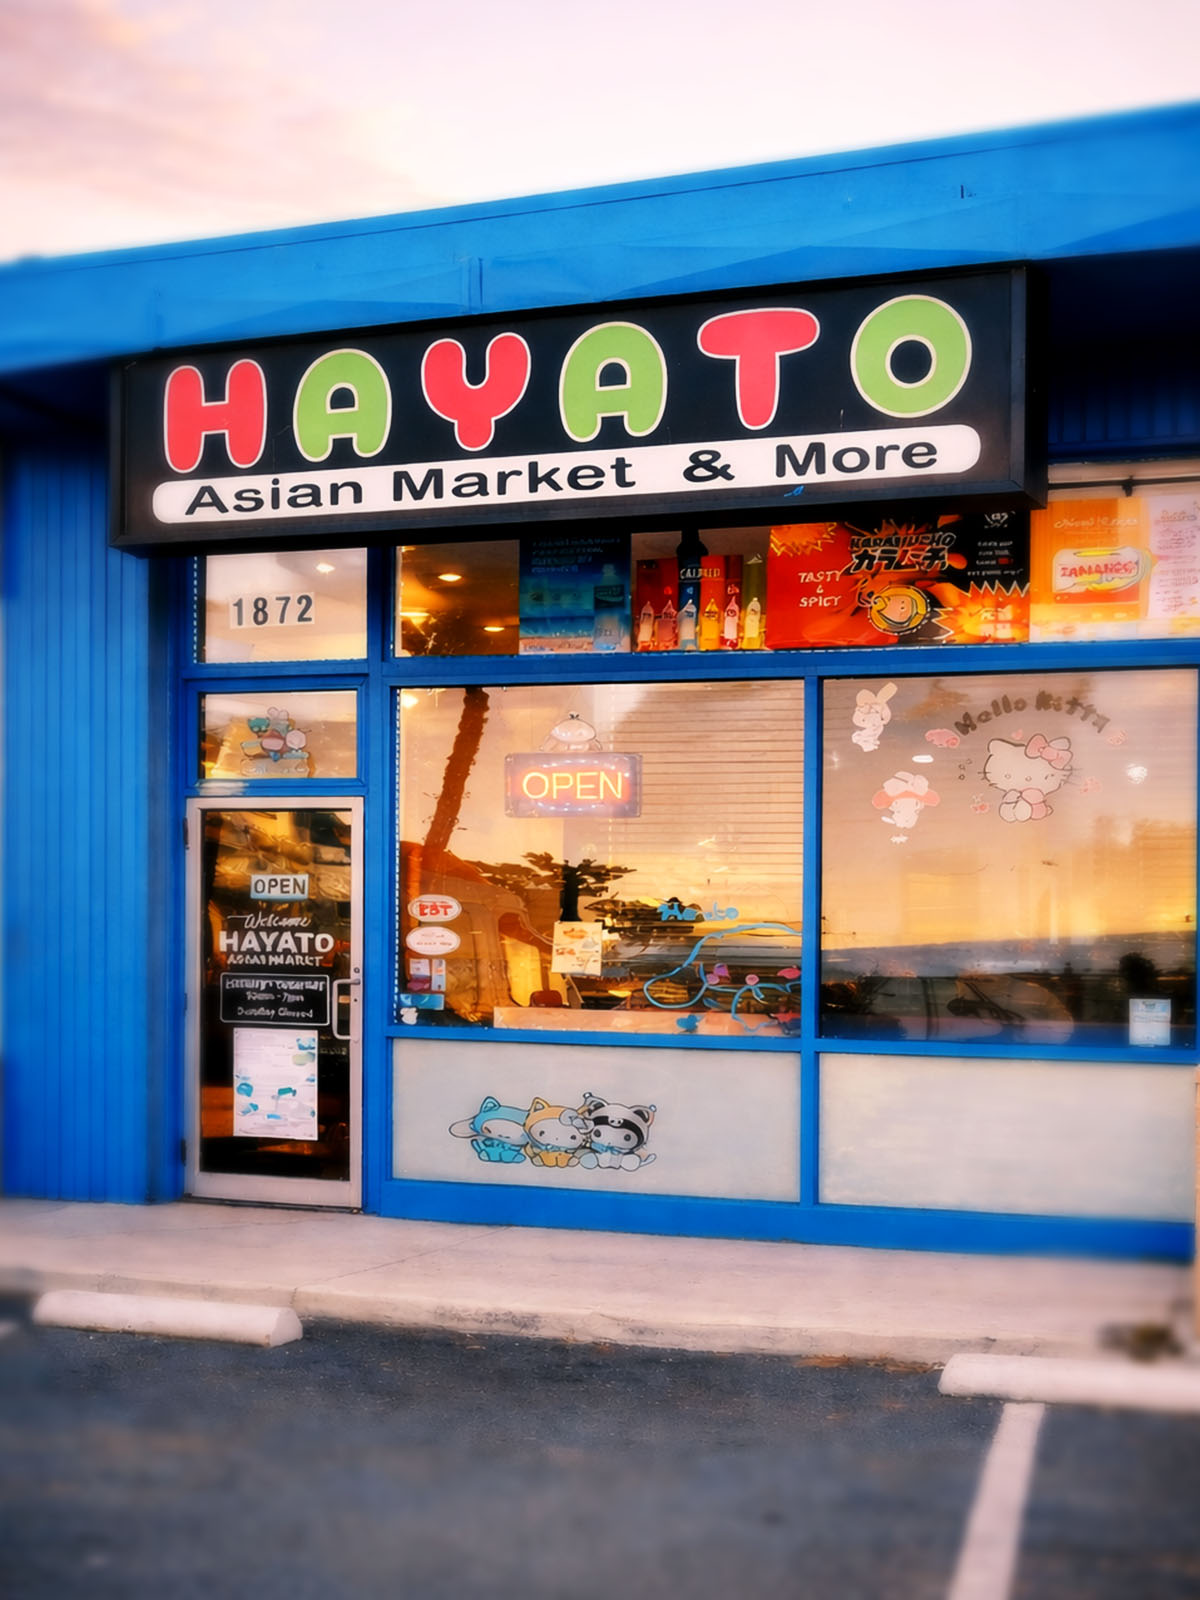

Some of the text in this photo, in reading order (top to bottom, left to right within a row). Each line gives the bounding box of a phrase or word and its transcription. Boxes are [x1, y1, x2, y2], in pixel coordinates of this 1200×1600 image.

[163, 294, 973, 475] HAYATO
[185, 441, 939, 516] Asian Market & More
[798, 570, 841, 584] TASTY
[231, 593, 315, 627] 1872
[522, 771, 623, 800] OPEN
[254, 878, 307, 895] OPEN
[218, 930, 335, 954] HAYATO
